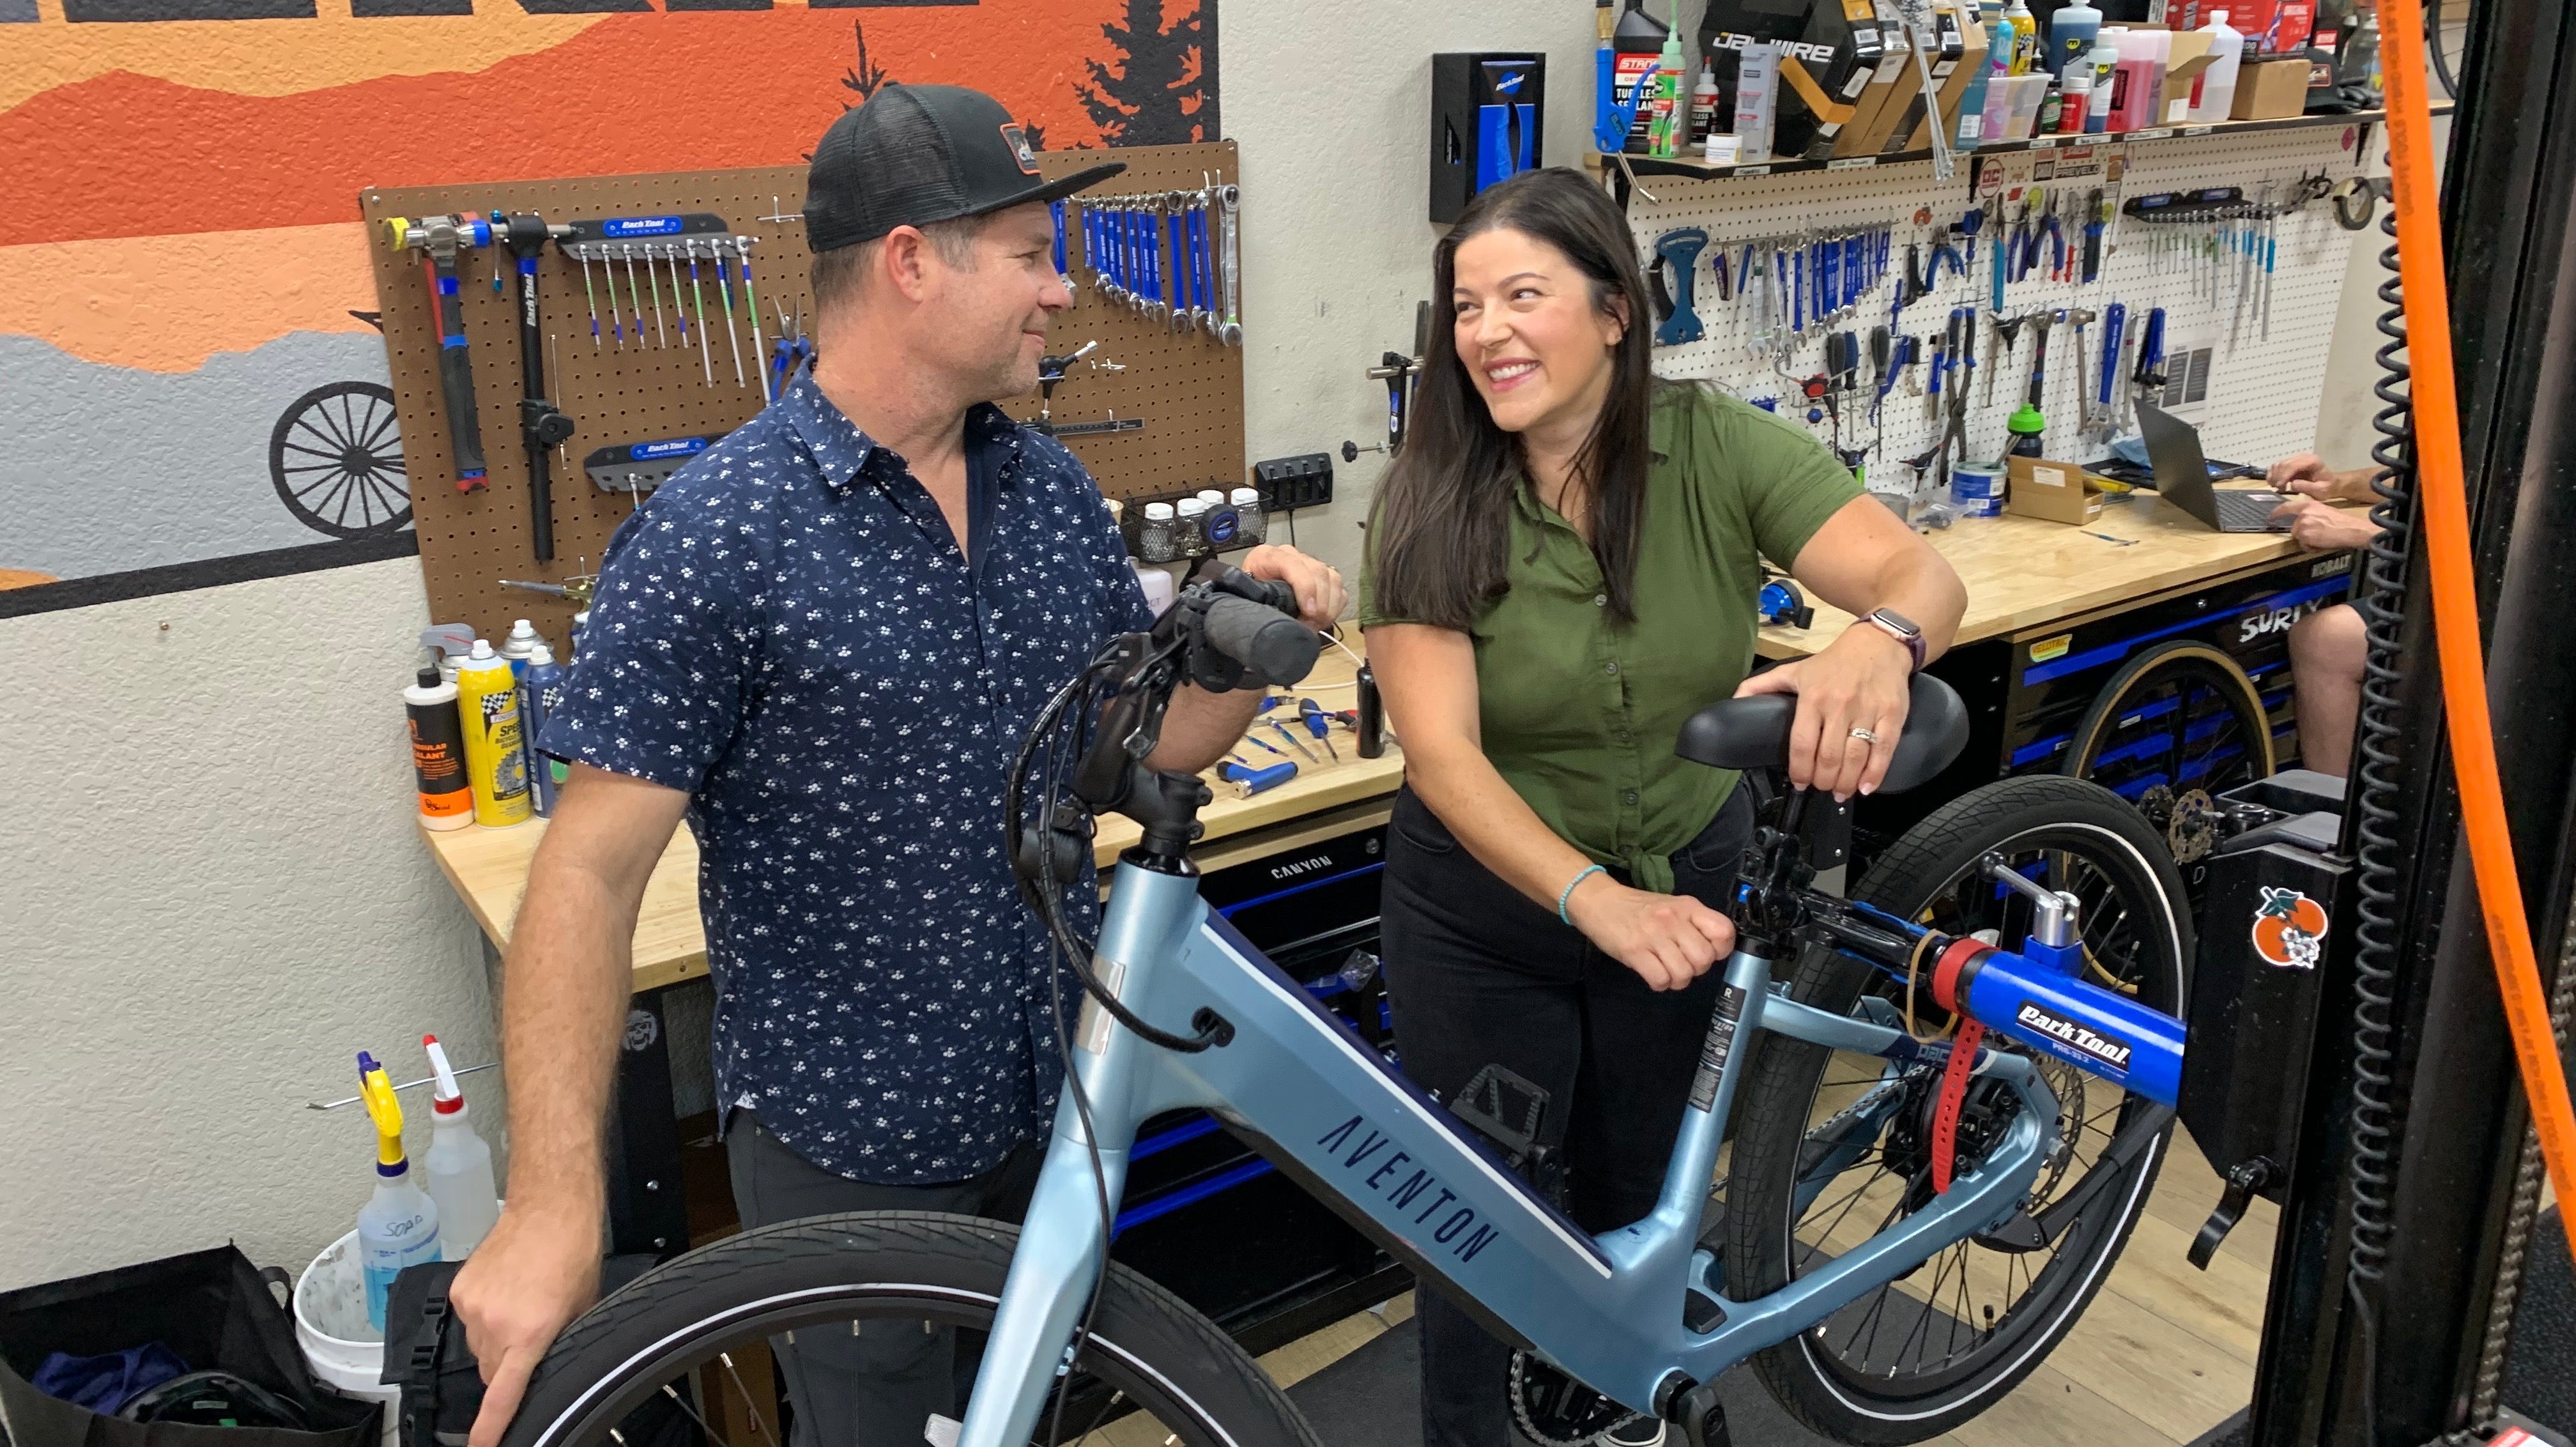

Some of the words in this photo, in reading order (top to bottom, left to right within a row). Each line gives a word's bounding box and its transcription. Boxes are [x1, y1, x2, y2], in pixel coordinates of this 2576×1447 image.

[1271, 855, 1333, 879] CANYON
[2018, 1005, 2076, 1038] Park
[1317, 1115, 1499, 1263] AVENTON
